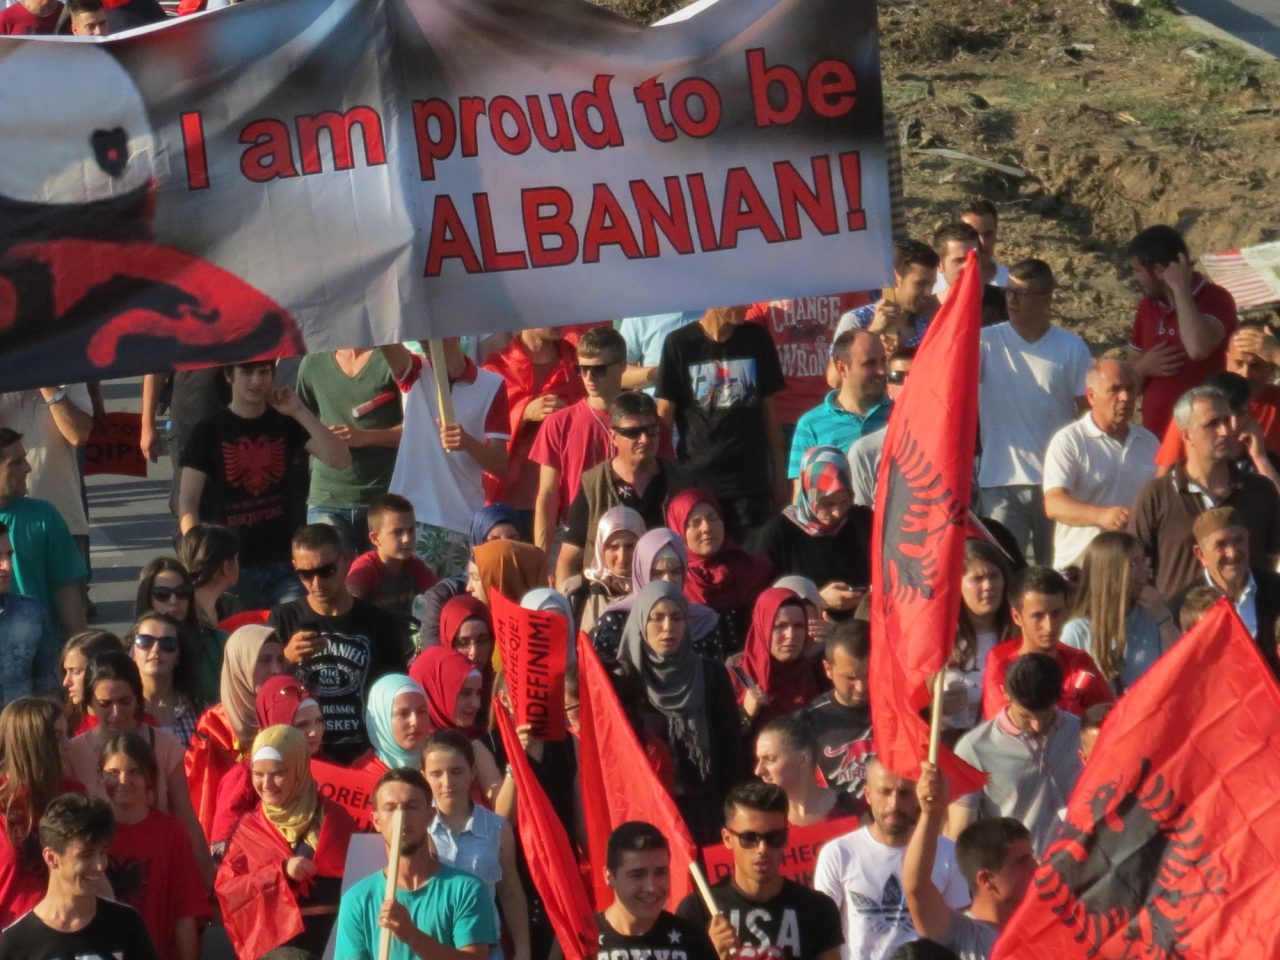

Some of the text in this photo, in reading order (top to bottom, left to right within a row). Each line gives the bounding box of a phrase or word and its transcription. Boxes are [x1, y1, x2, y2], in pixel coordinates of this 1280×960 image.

[180, 48, 858, 190] I am proud to be
[424, 151, 868, 278] ALBANIAN!
